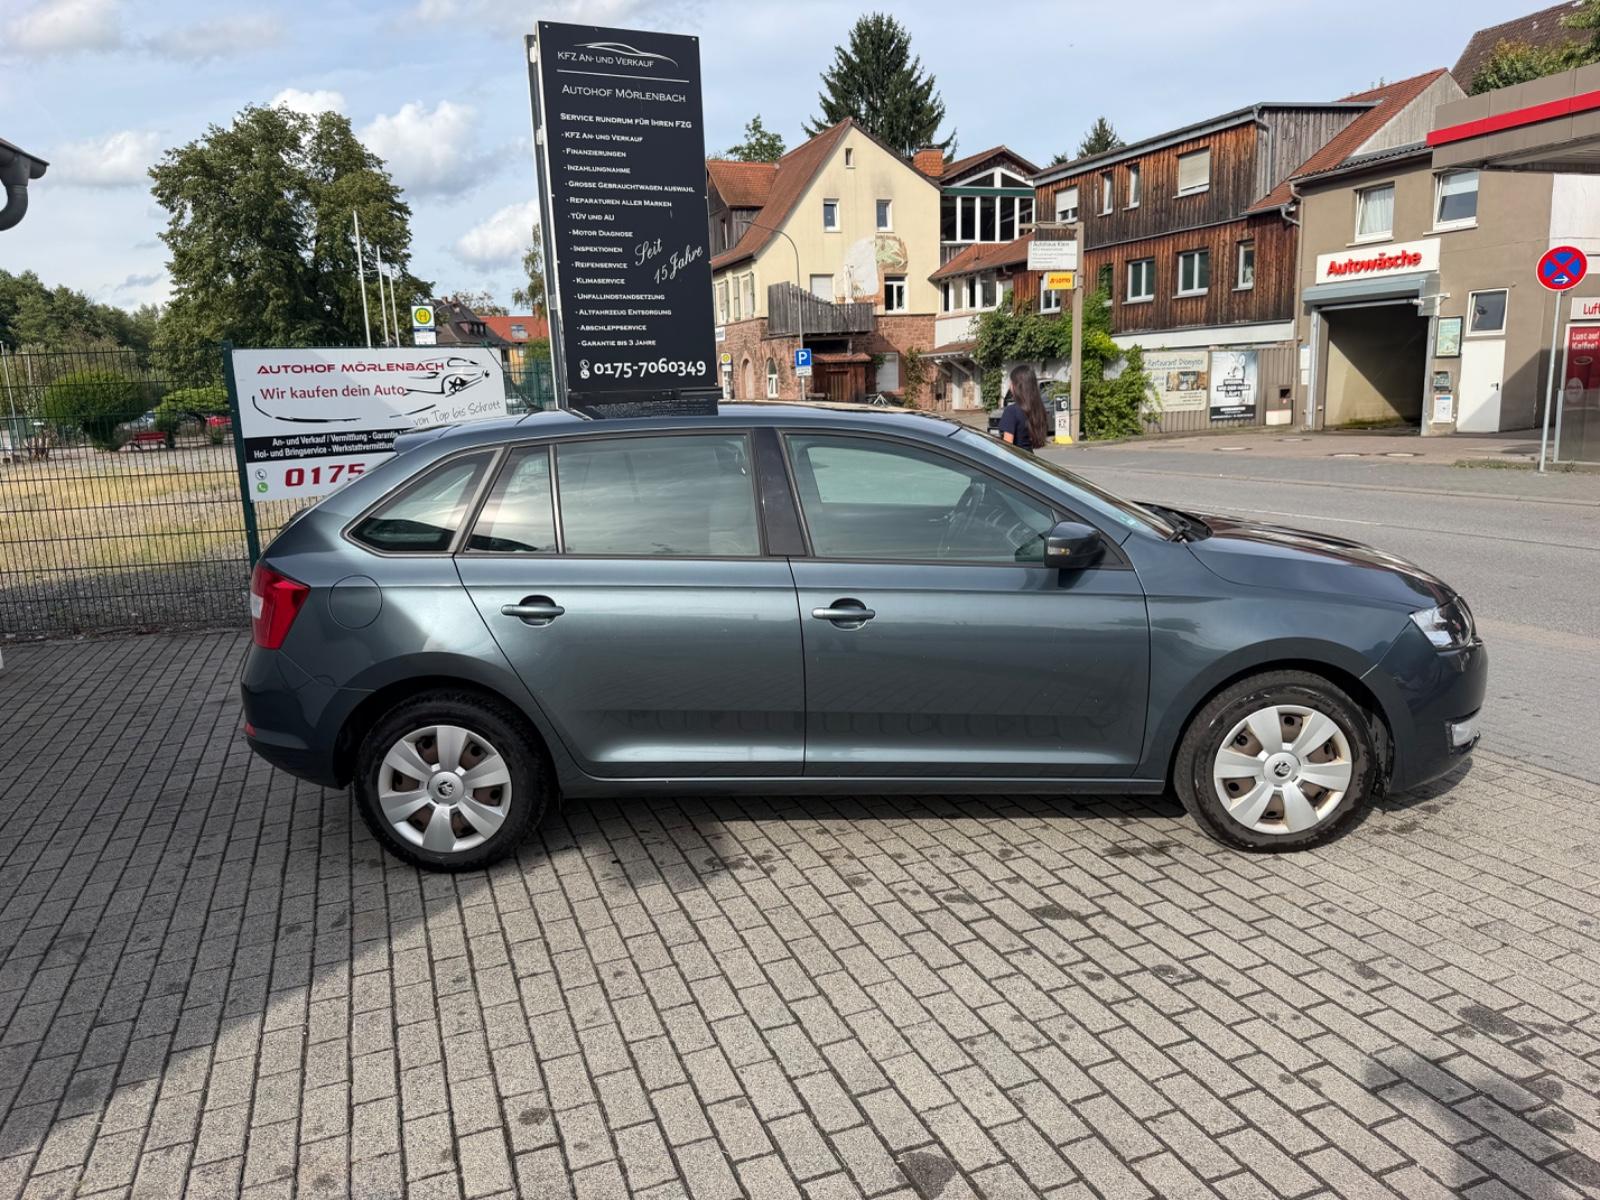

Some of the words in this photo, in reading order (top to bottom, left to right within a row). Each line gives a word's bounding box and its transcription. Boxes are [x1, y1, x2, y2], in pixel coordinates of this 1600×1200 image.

[557, 51, 577, 61] KFZ
[615, 57, 654, 68] VERKAUF
[562, 84, 613, 97] AUTOHOF
[615, 88, 686, 102] MÖRLENBACH
[560, 112, 594, 122] SERVICE
[675, 120, 692, 129] FZG
[634, 238, 663, 266] Seit
[654, 264, 668, 285] 15
[669, 244, 703, 280] Jahre
[1327, 250, 1422, 276] Autowäsche
[1572, 331, 1587, 340] Lust
[798, 351, 808, 365] P
[257, 364, 336, 375] AUTOHOF
[341, 361, 445, 373] MÖRLENBACH
[594, 357, 706, 379] 0175-7060349
[260, 387, 287, 400] Wir
[289, 385, 338, 399] kaufen
[341, 384, 370, 397] dein
[374, 385, 405, 396] Auto
[414, 417, 429, 426] von
[431, 409, 450, 423] Top
[452, 408, 466, 418] bis
[467, 400, 501, 415] Schrott
[272, 437, 285, 447] An-
[286, 436, 300, 446] und
[300, 434, 326, 444] Verkauf
[330, 431, 368, 443] Vermittlung
[270, 448, 284, 458] und
[285, 446, 327, 458] Bringservice
[331, 441, 396, 452] Werkstattvermittlun
